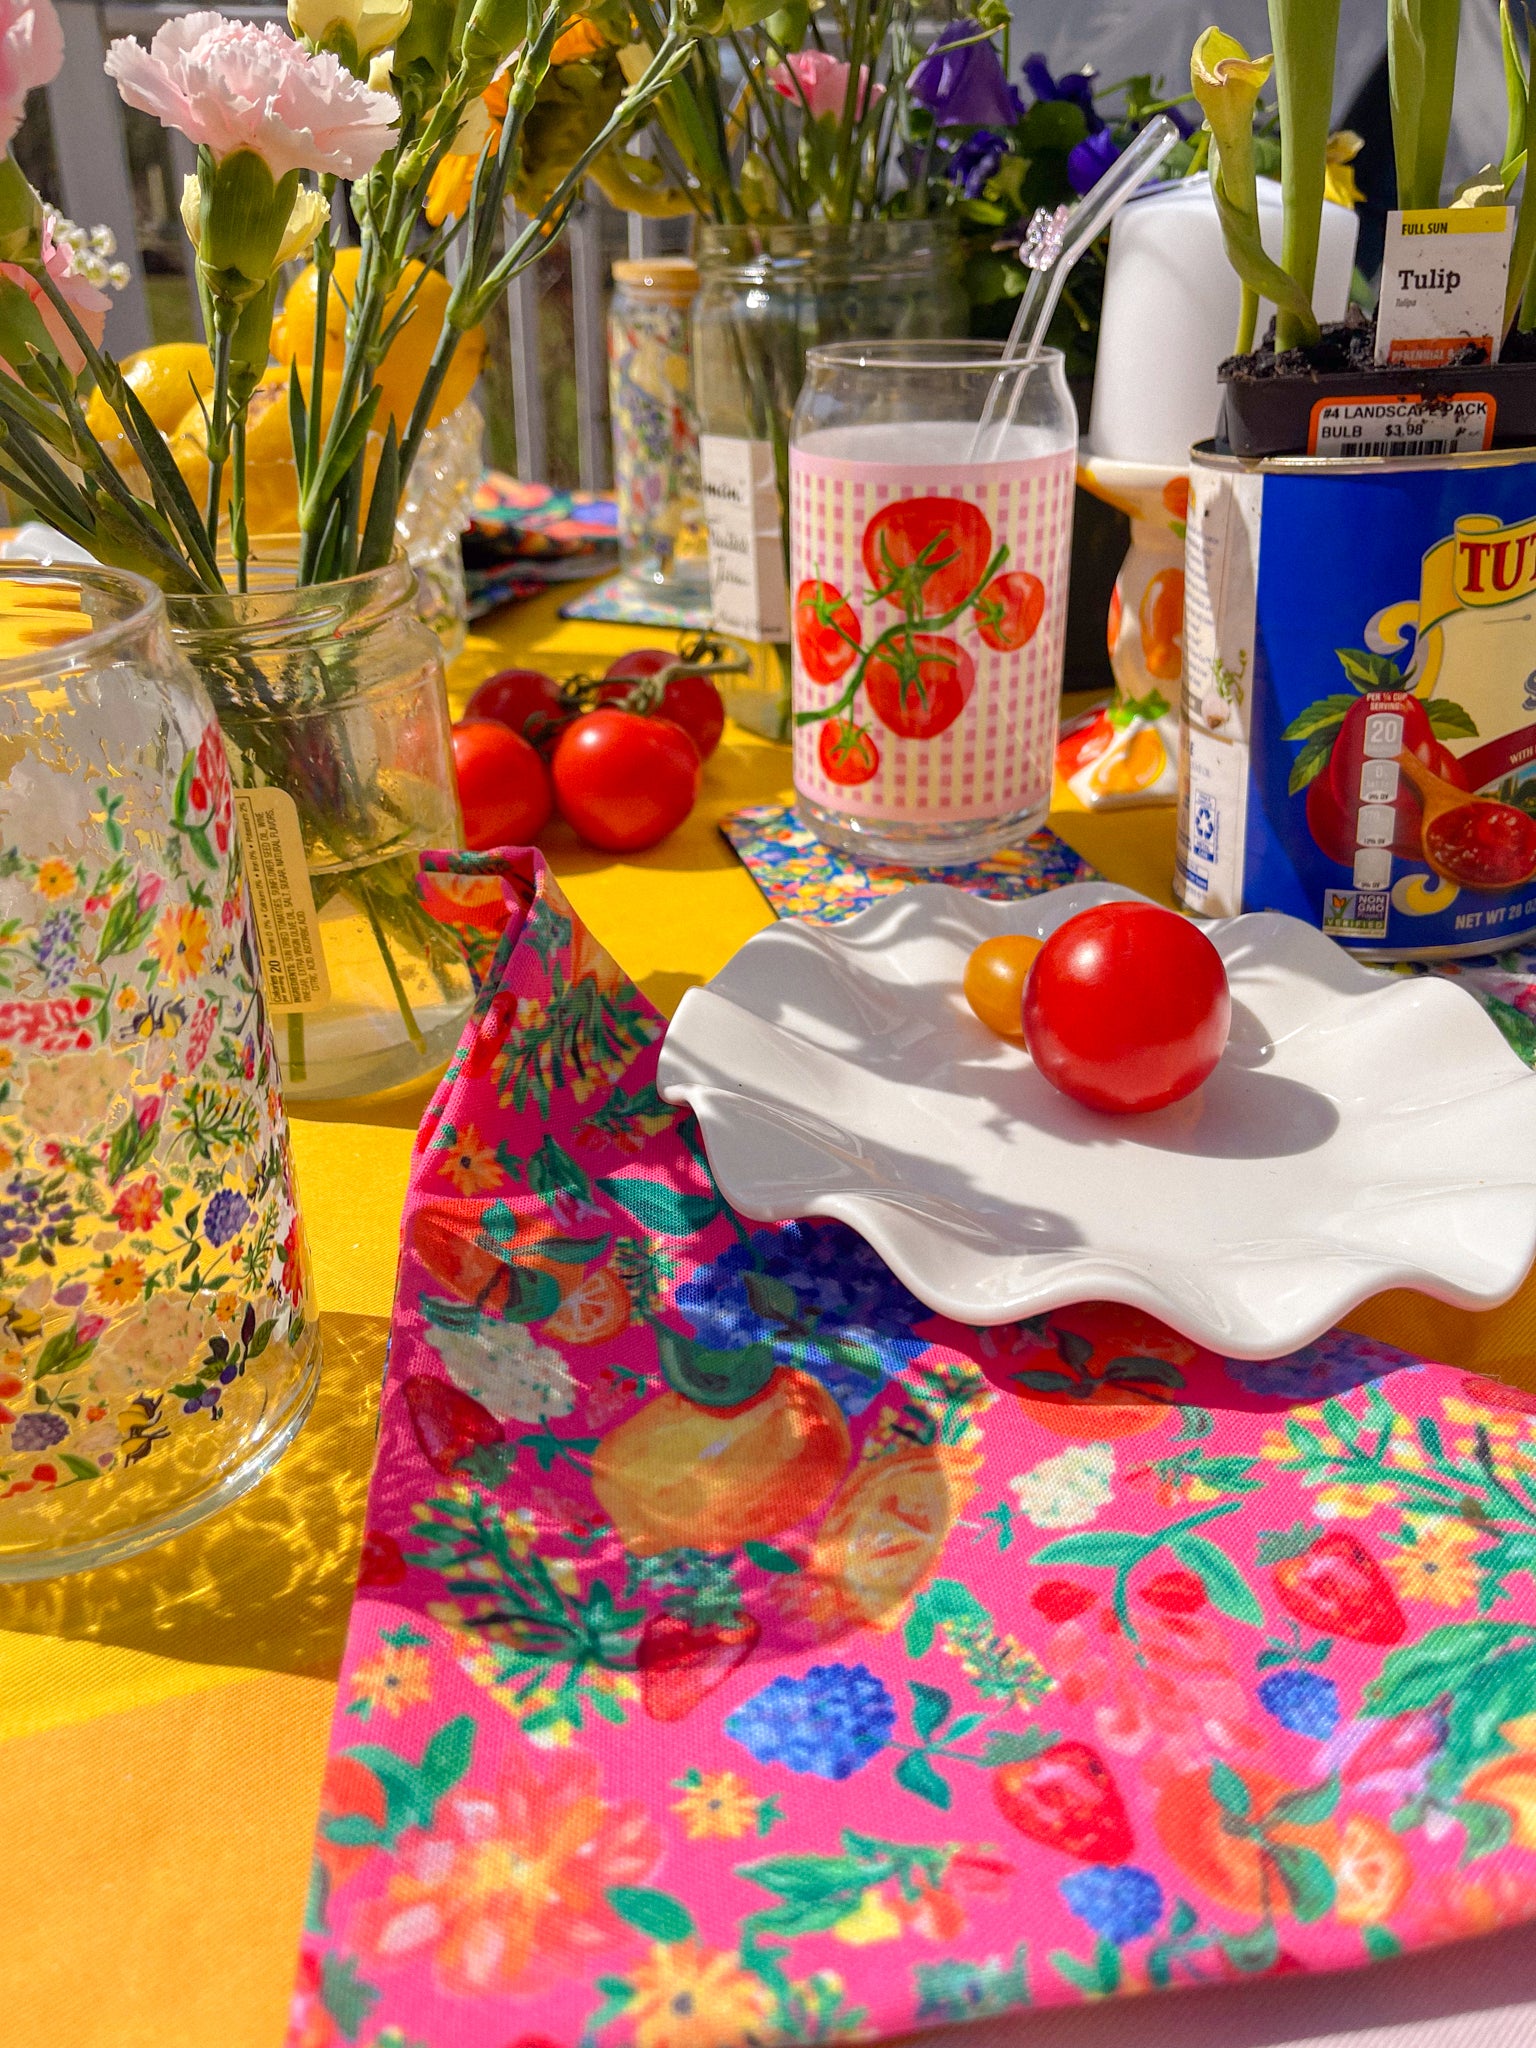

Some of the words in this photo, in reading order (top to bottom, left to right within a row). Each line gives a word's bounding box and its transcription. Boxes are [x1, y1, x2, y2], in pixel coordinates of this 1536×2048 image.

[1402, 223, 1424, 235] FULL
[1427, 222, 1448, 233] SUN
[1398, 268, 1460, 293] Tulip
[1323, 408, 1339, 419] #4
[1345, 404, 1439, 419] LANDSCAPE
[1445, 402, 1487, 416] PACK
[1322, 425, 1362, 438] BULB
[1385, 424, 1423, 437] $3.98
[1460, 533, 1536, 592] TU
[1371, 720, 1397, 742] 20
[1510, 745, 1533, 765] WITH
[1358, 903, 1384, 912] GMO
[1359, 895, 1385, 904] NON
[1328, 919, 1383, 929] VERIFIED
[1455, 912, 1482, 930] NET
[1486, 907, 1506, 925] WT
[1508, 903, 1523, 920] 28
[268, 960, 282, 973] 20
[270, 975, 281, 1002] Calories
